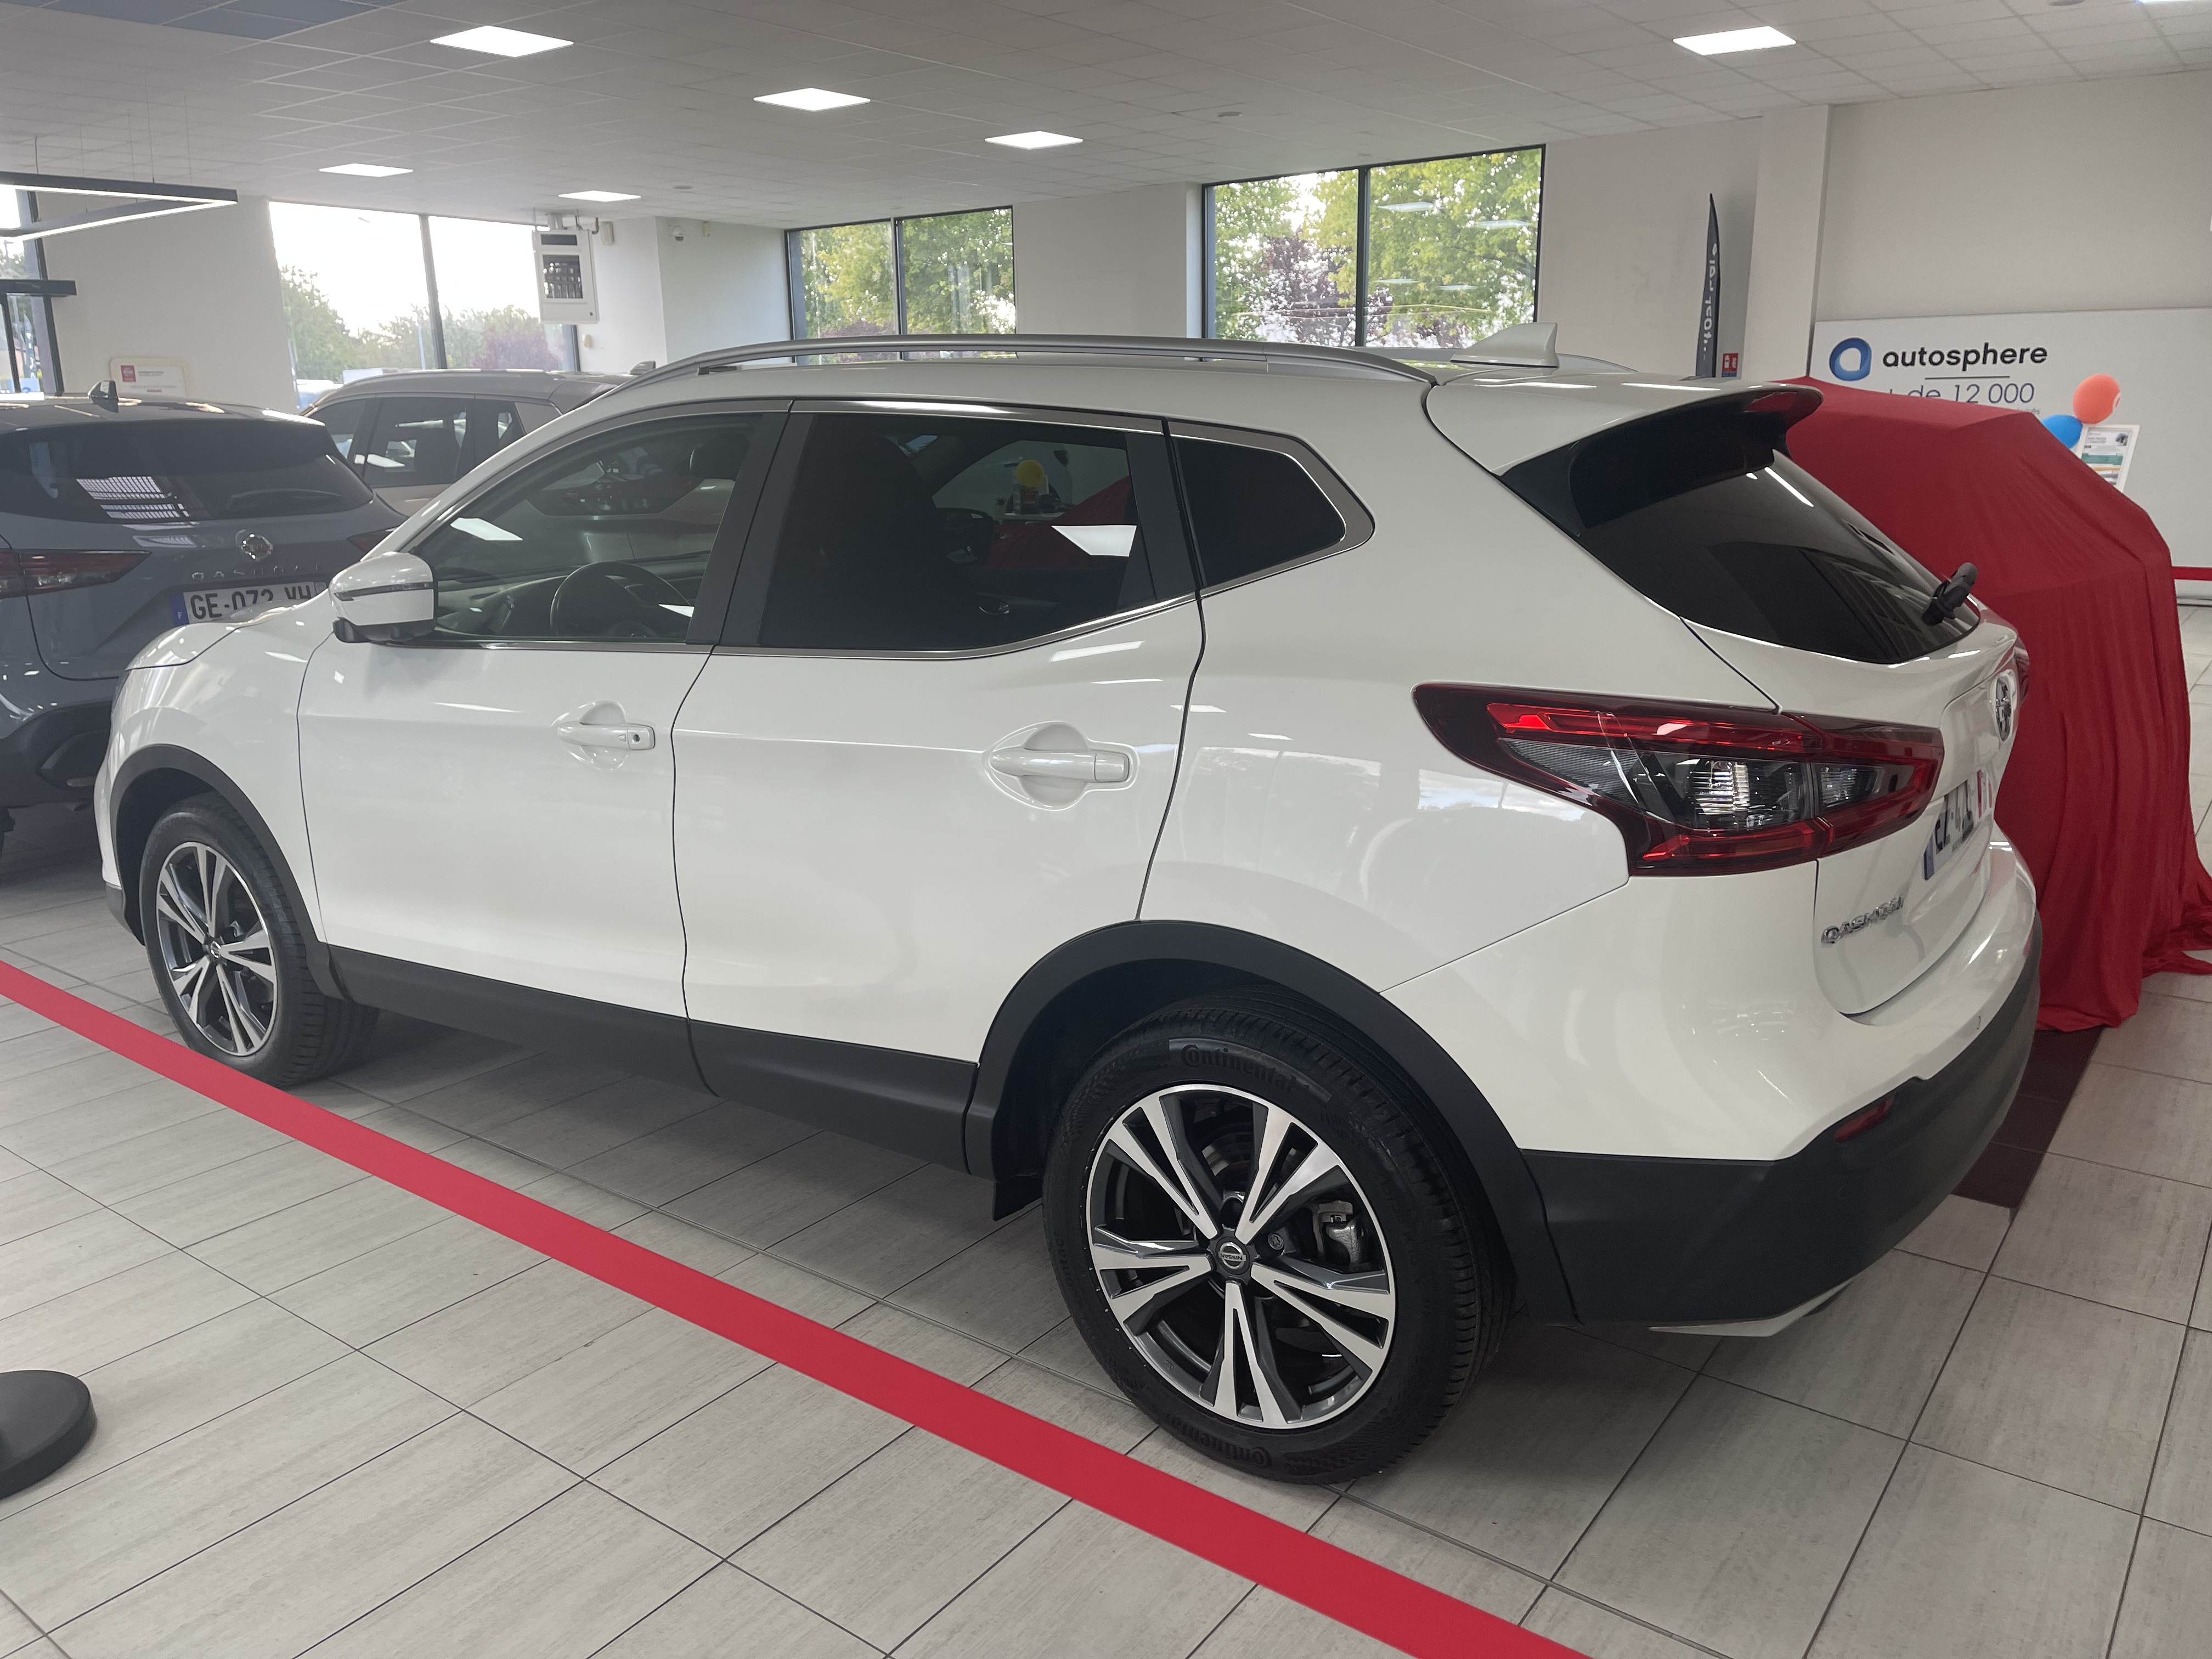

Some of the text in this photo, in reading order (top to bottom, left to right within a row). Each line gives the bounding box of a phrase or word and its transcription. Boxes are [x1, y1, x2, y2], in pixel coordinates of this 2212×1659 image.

[1883, 342, 2047, 371] autosphere
[1955, 383, 1980, 403] 12
[1988, 383, 2035, 403] 000
[1181, 1044, 1297, 1093] Continental
